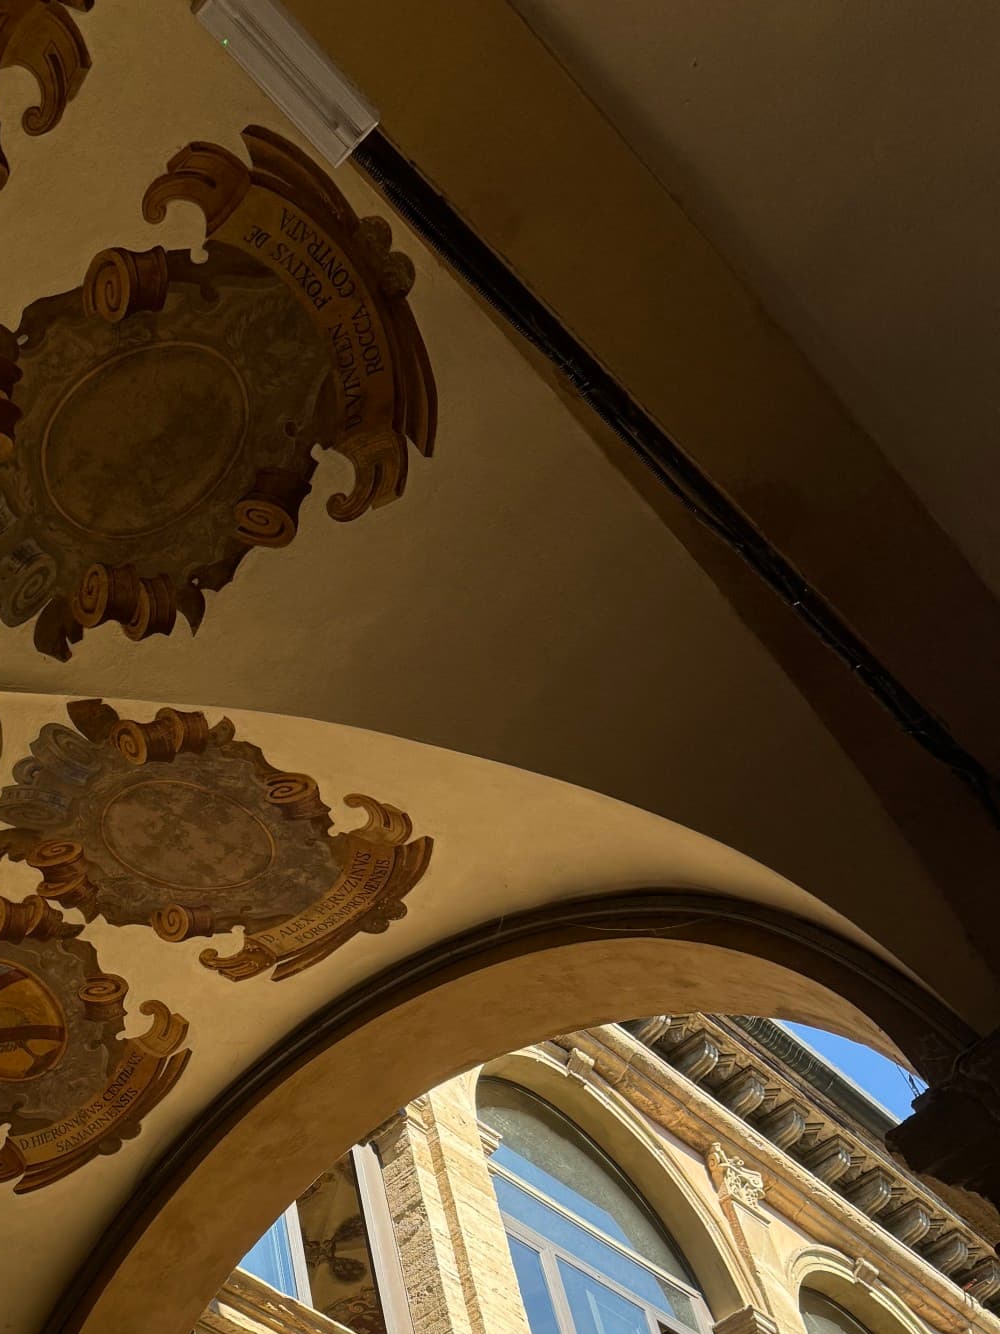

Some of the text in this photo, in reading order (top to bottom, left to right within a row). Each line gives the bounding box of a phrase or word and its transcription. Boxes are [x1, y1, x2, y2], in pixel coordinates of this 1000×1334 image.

[243, 224, 272, 249] DE
[279, 207, 385, 377] ROCCA CONTRATA
